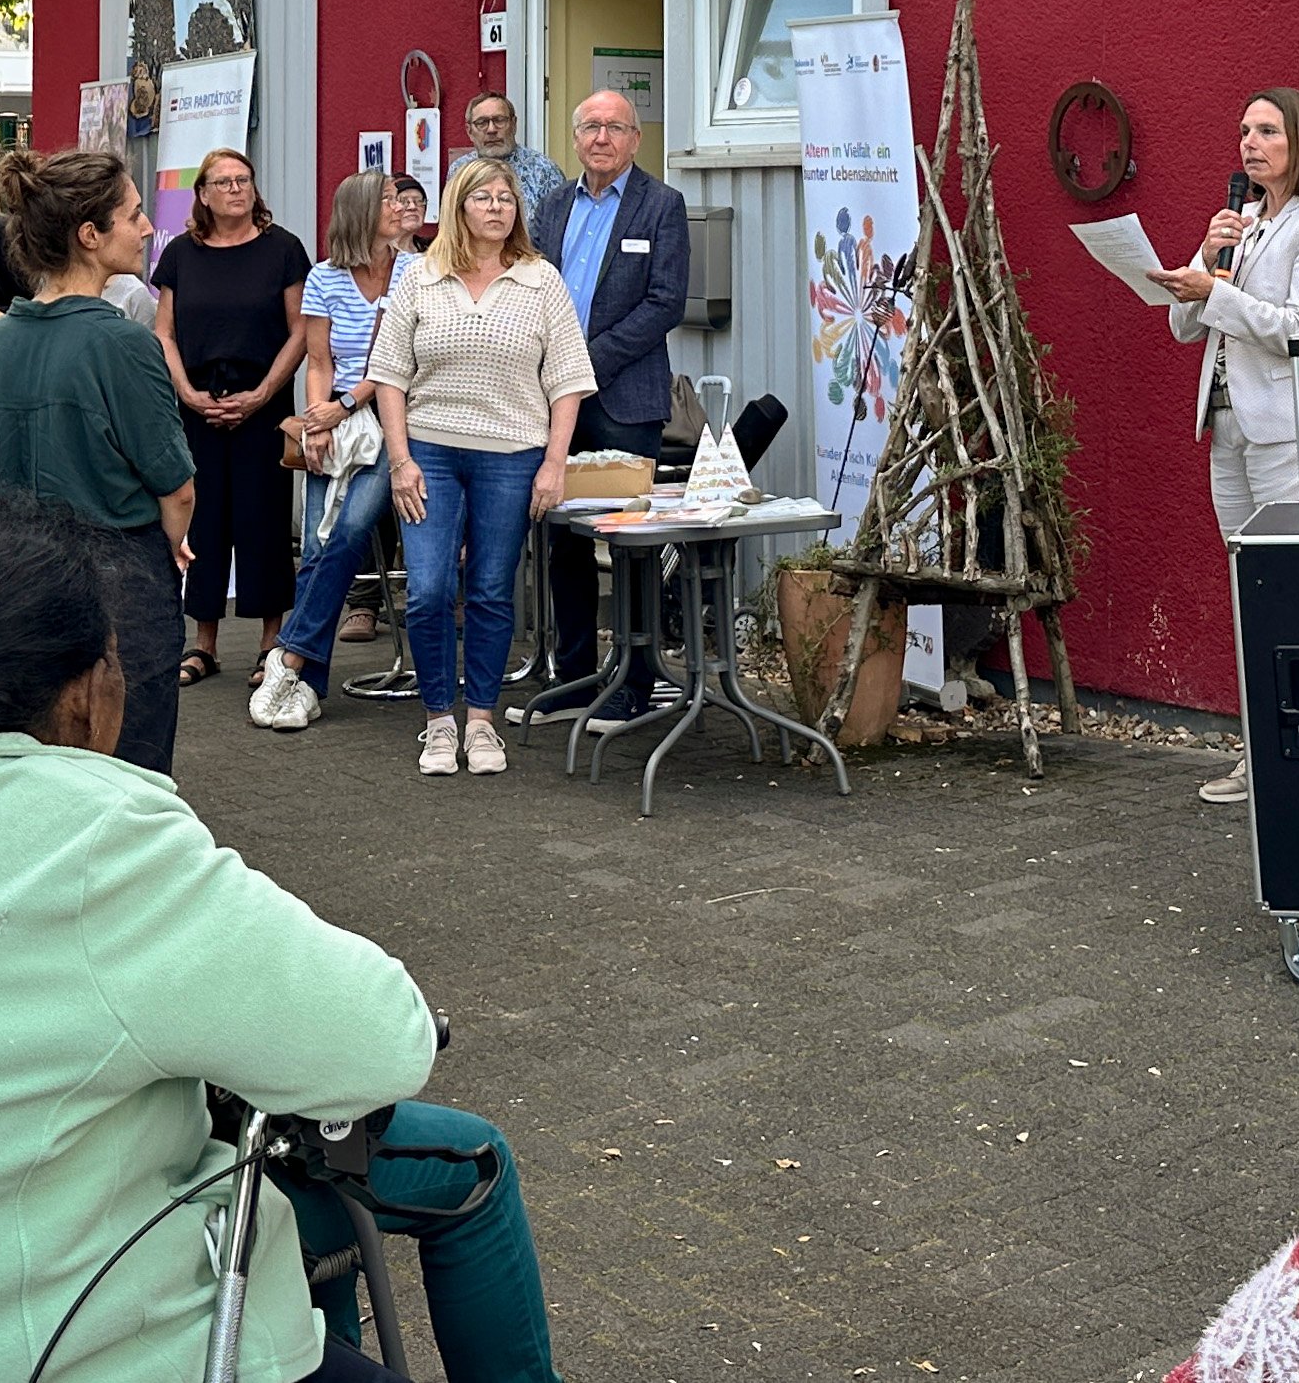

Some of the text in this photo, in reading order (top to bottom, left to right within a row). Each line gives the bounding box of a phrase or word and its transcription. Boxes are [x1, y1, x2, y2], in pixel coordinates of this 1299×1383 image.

[490, 24, 502, 43] 61
[805, 142, 830, 158] Altern
[832, 142, 841, 158] in
[843, 142, 871, 158] Vielfalt
[877, 142, 891, 159] ein
[831, 165, 899, 183] Lebensabschnitt
